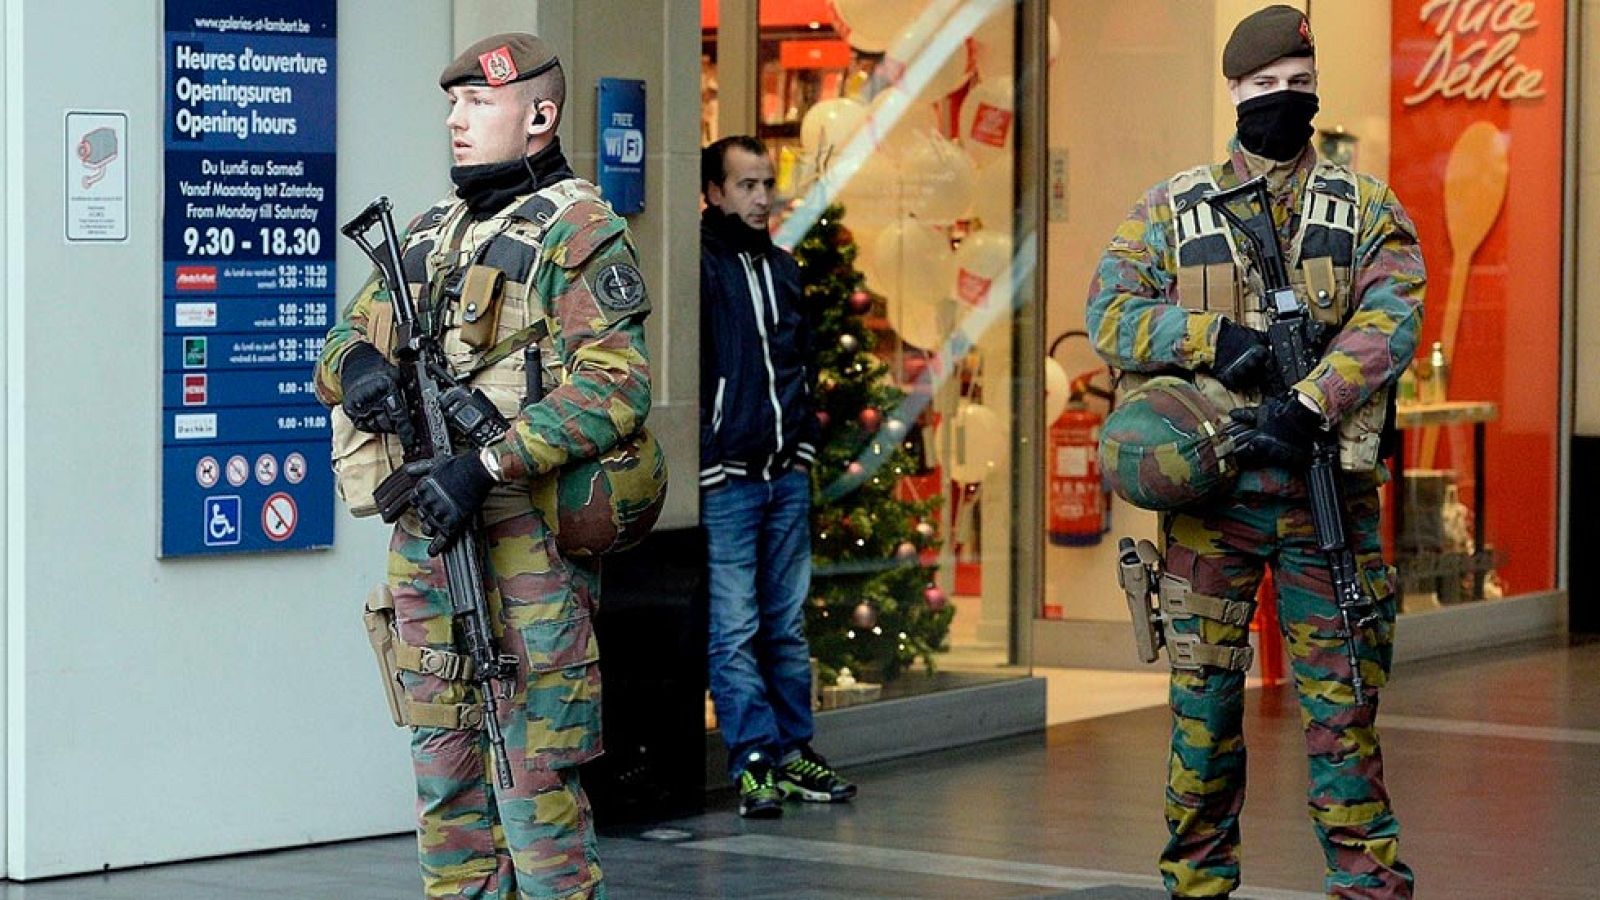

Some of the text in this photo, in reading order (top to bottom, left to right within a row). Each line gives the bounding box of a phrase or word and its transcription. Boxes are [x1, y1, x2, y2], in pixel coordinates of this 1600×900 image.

[194, 15, 310, 33] www.galeries-st-lambert.be
[176, 45, 327, 74] Heures d'ouverture
[1403, 31, 1546, 105] Délice
[176, 76, 292, 108] Openingsuren
[176, 108, 297, 139] Opening hours
[202, 159, 304, 176] Du Lundi au Samedi
[179, 180, 324, 201] Vanaf Maandag tot Zaterdag
[186, 203, 319, 223] From Monday till Saturday
[183, 226, 321, 256] 9.30 - 18.30
